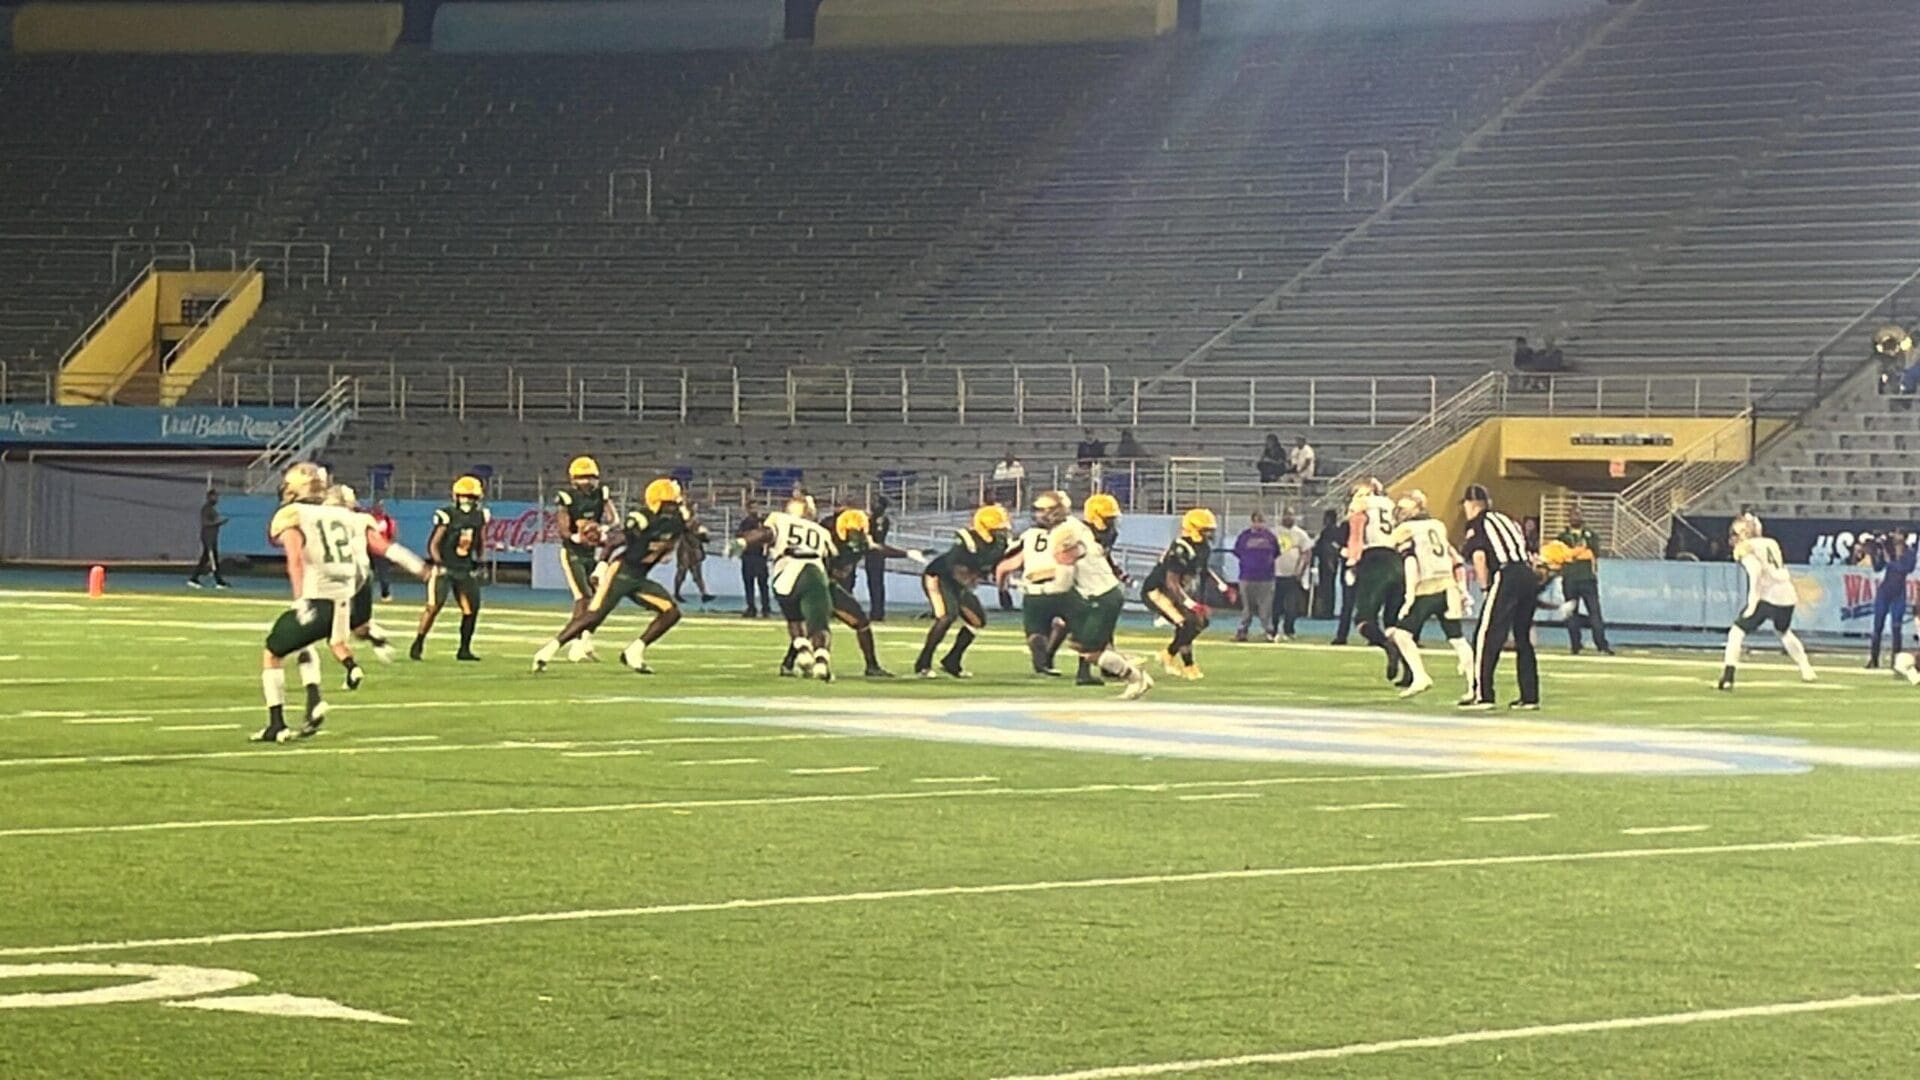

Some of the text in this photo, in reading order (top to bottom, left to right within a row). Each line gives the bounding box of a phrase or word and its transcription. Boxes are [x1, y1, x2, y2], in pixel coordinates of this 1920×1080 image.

[196, 414, 240, 438] Baton
[1379, 506, 1393, 535] 5
[316, 519, 353, 563] 12
[787, 523, 820, 550] 50
[1035, 533, 1048, 552] 6
[1427, 528, 1444, 557] 9
[1766, 546, 1779, 569] 4
